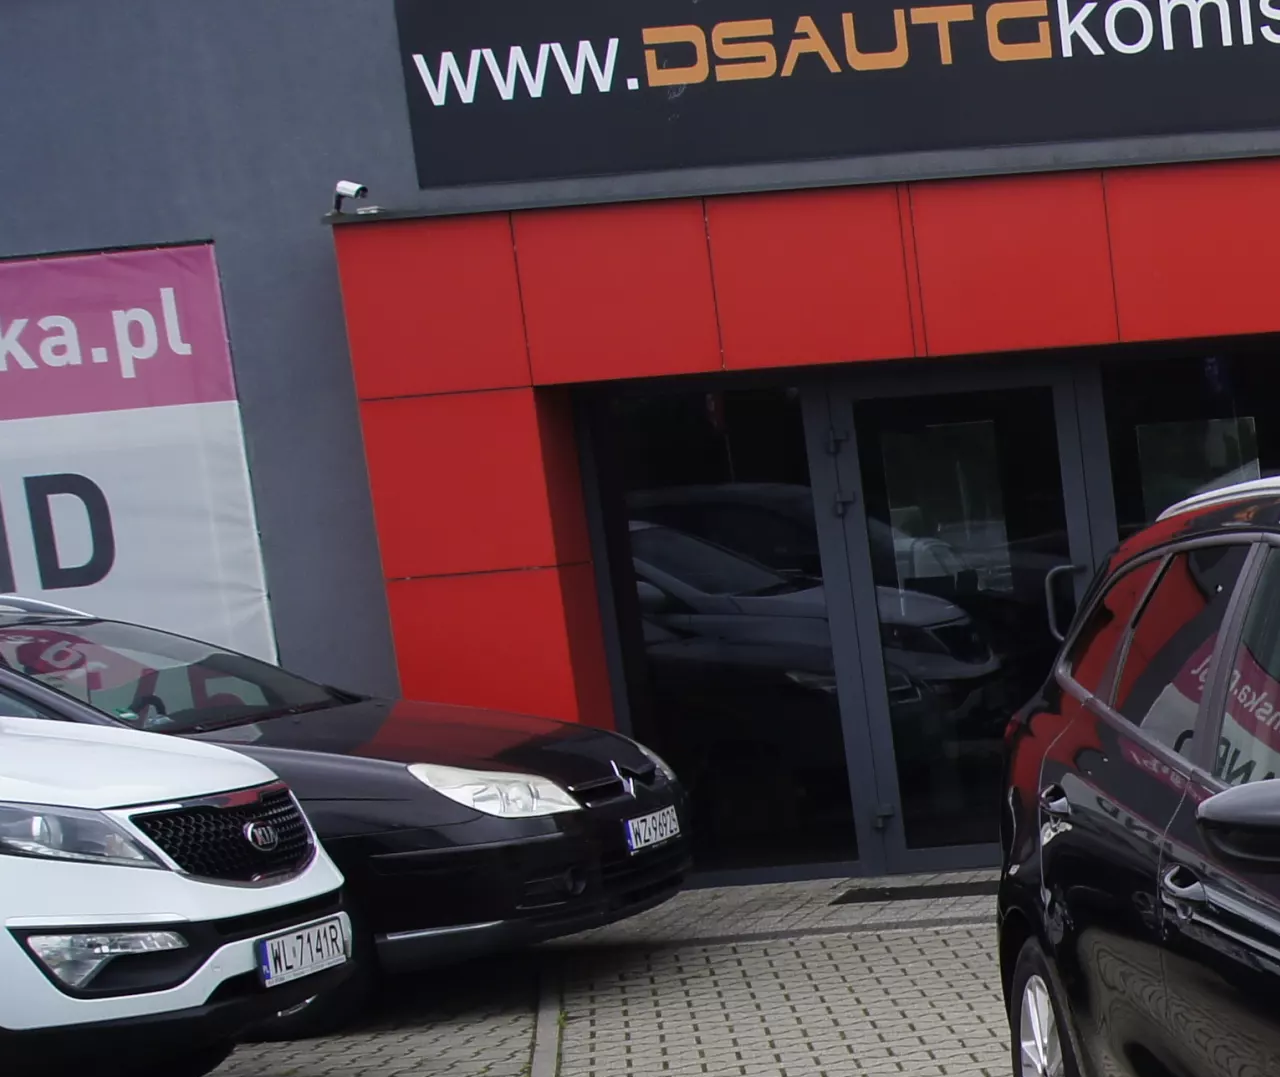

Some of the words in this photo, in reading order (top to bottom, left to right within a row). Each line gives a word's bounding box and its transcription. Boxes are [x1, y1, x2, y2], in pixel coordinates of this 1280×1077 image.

[0, 472, 116, 595] D
[631, 817, 650, 848] WZ
[270, 939, 294, 975] WL
[296, 924, 341, 967] 7141R
